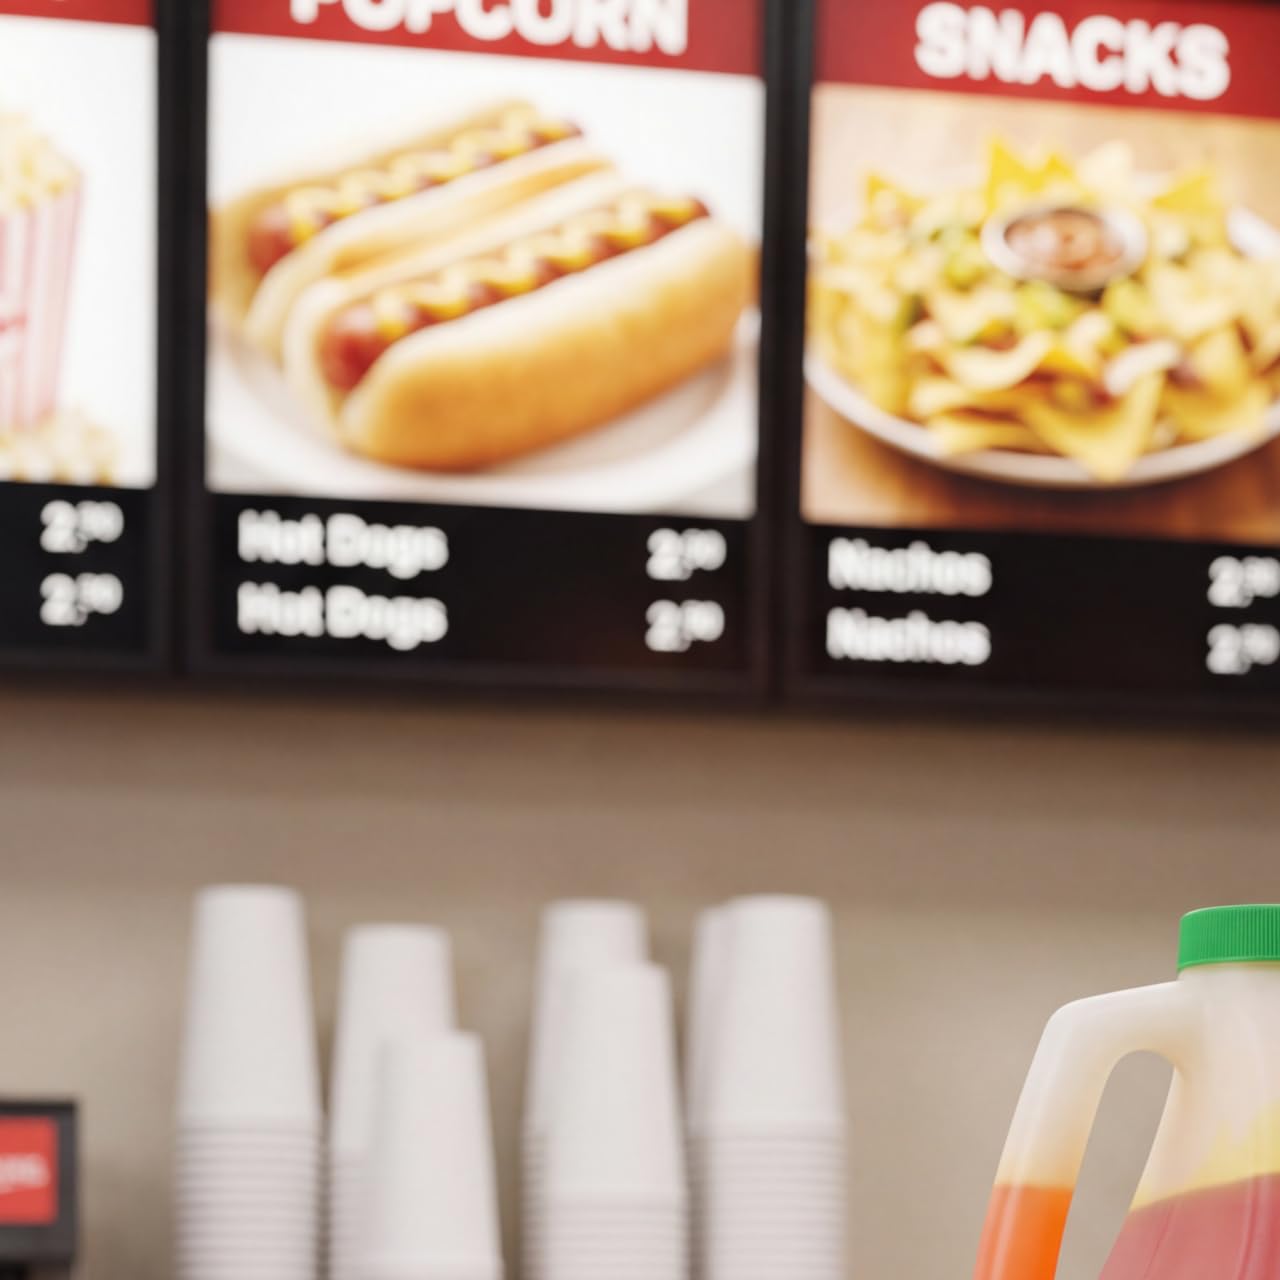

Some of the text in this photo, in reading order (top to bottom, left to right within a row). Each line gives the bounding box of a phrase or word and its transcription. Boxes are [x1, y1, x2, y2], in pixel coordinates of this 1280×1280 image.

[290, 0, 688, 56] CORN
[914, 2, 1231, 101] SNACKS
[238, 508, 449, 579] Hot Dogs
[828, 537, 992, 596] Nachos
[238, 580, 448, 650] Hot Dogs
[826, 606, 991, 666] Nachos
